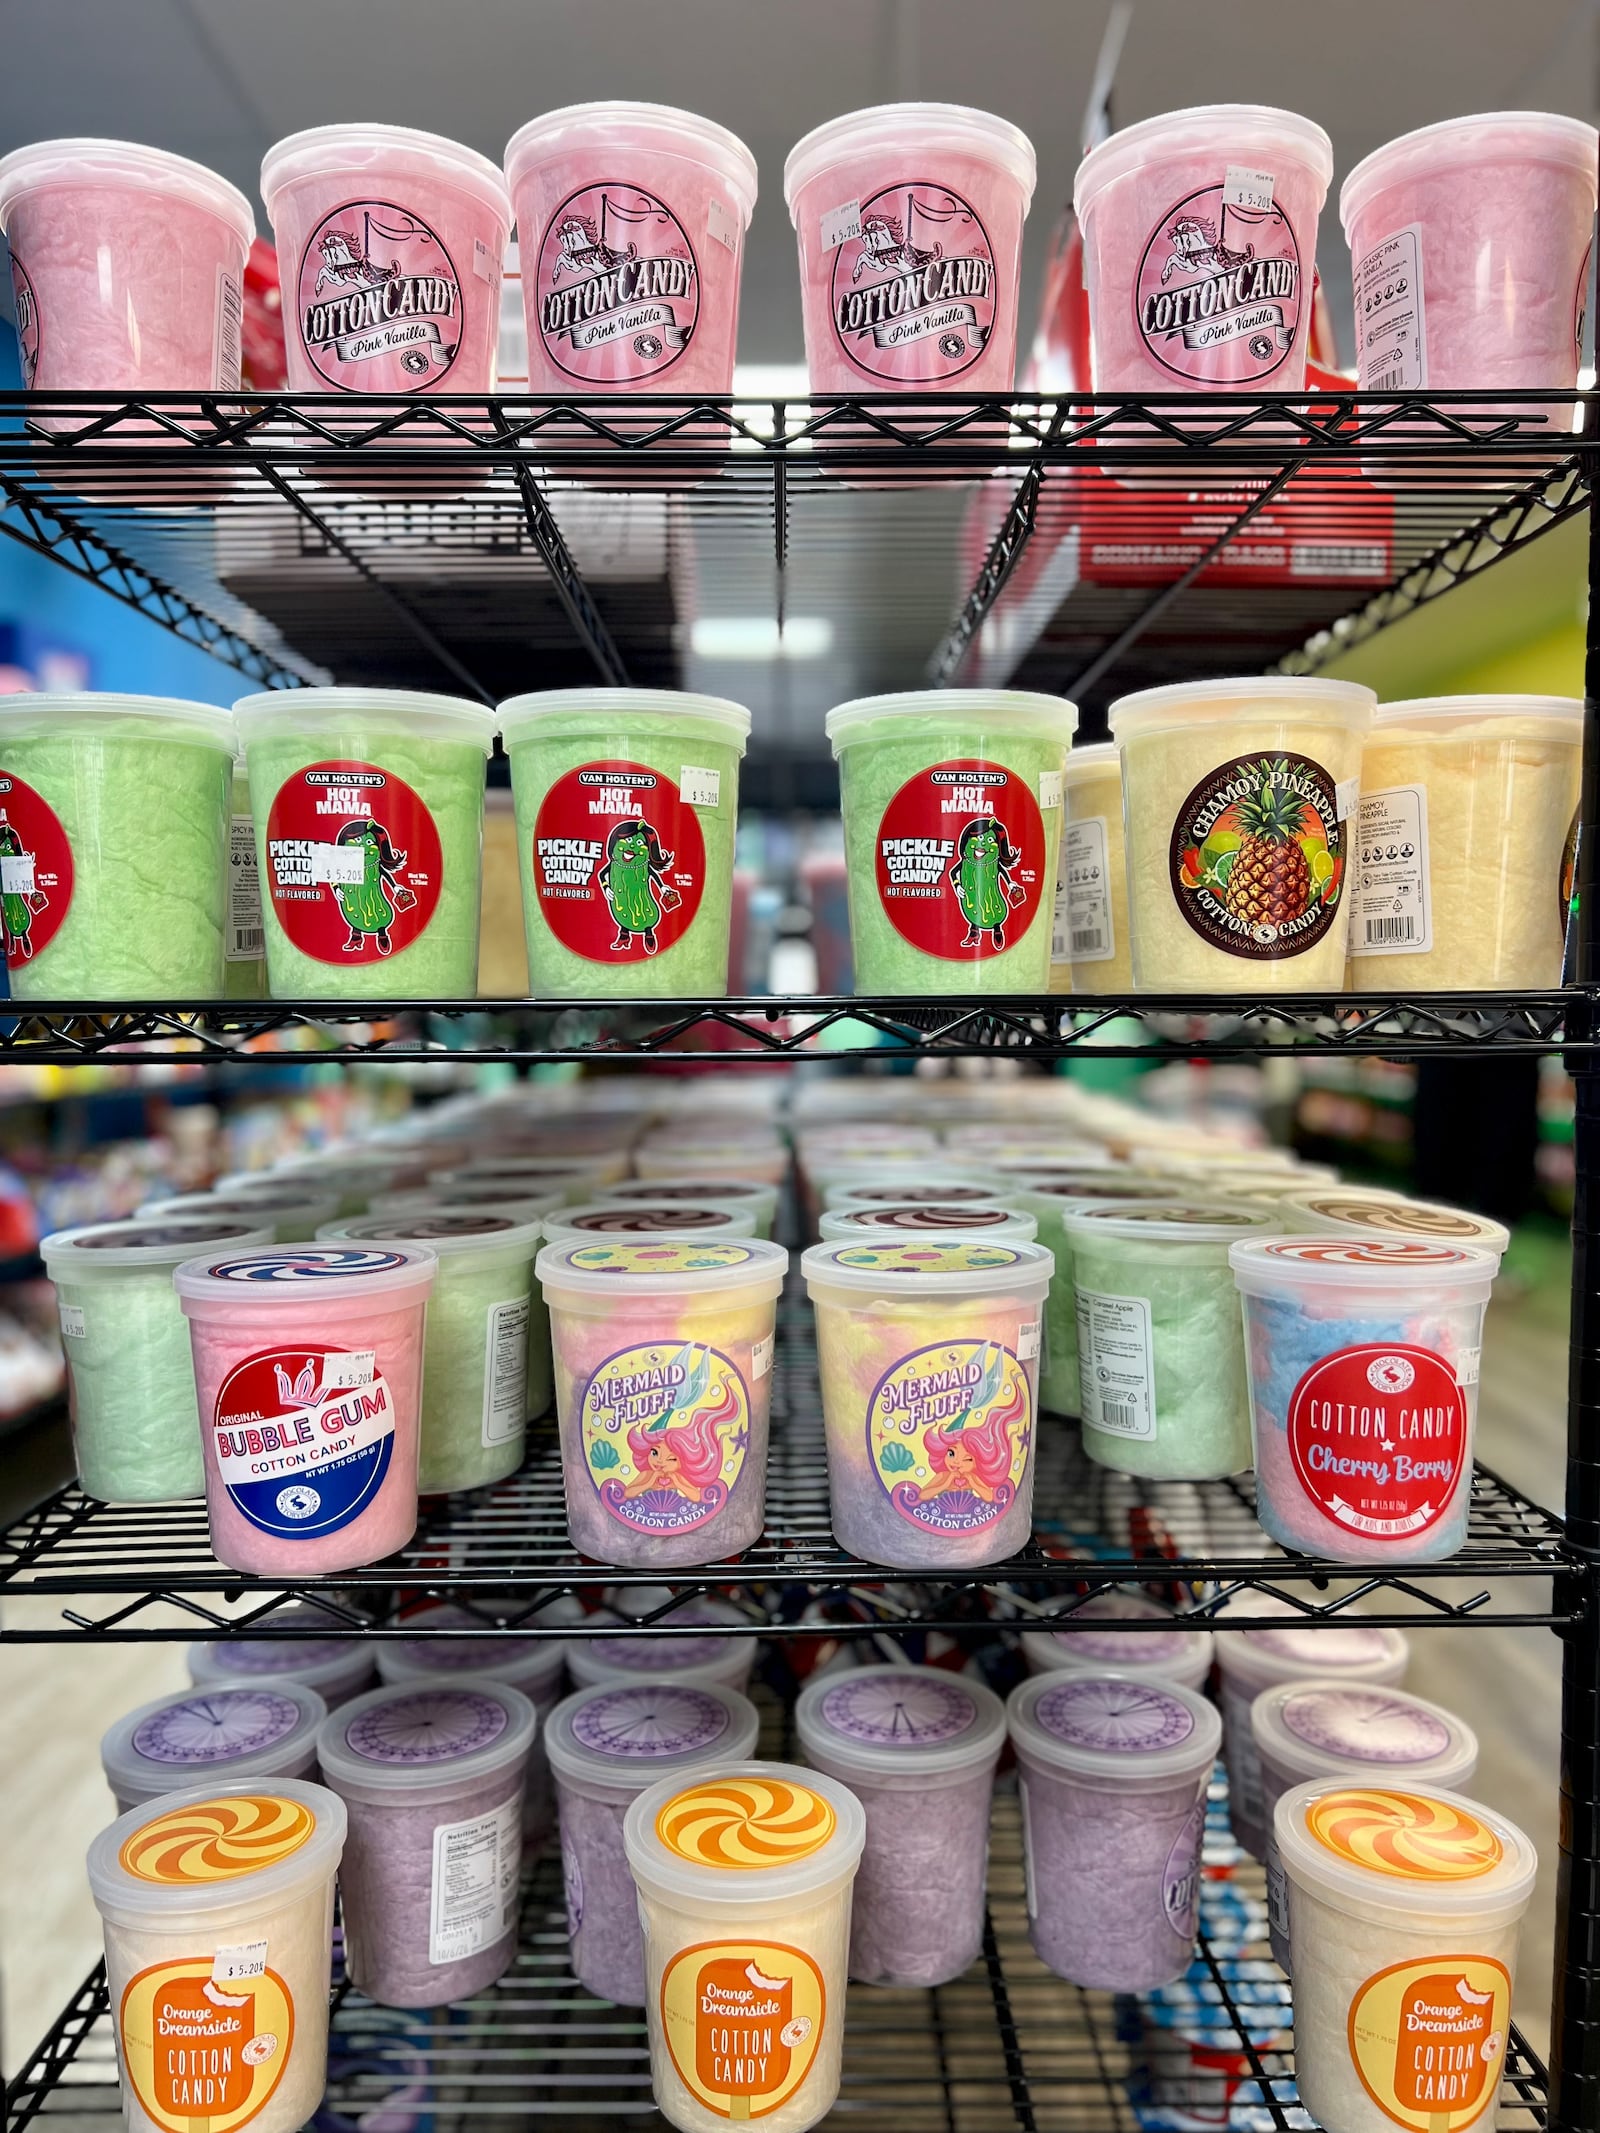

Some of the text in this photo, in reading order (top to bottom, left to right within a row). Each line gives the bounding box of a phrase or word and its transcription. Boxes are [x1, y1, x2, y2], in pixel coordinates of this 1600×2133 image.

[585, 309, 661, 344] Pink Vanilla
[889, 308, 964, 343] Pink Vanilla
[1199, 309, 1273, 345] Pink Vanilla
[350, 325, 426, 357] Pink Vanilla
[308, 774, 382, 785] VAN HOLTEN'S
[582, 774, 653, 786] VAN HOLTEN'S
[934, 773, 1004, 783] VAN HOLTEN'S
[326, 787, 361, 802] HOT
[599, 787, 633, 802] HOT
[952, 786, 985, 800] HOT
[316, 800, 372, 816] MAMA
[588, 800, 643, 817] MAMA
[940, 799, 994, 815] MAMA
[1192, 771, 1339, 845] CHAMOY PINEAPPLE
[1360, 801, 1385, 812] CHAMOY
[537, 839, 603, 860] PICKLE
[881, 838, 955, 857] PICKLE
[273, 857, 313, 871] COTTO
[541, 856, 594, 873] COTTON
[886, 856, 946, 871] COTTON
[544, 869, 591, 886] CANDY
[889, 869, 944, 885] CANDY
[275, 889, 321, 899] HOT FLAVORED
[542, 888, 591, 899] HOT FLAVORED
[887, 887, 941, 897] HOT FLAVORED
[1197, 888, 1254, 936] COTTON
[1278, 901, 1324, 937] CANDY
[1370, 1357, 1412, 1373] CHOCOLATE
[590, 1364, 686, 1411] MERMAID
[881, 1363, 982, 1414] MERMAID
[1370, 1375, 1412, 1392] STORYBOOK
[219, 1411, 264, 1425] ORIGINAL
[605, 1388, 677, 1433] FLUFF
[899, 1387, 974, 1434] FLUFF
[1310, 1399, 1454, 1439] COTTON CANDY
[217, 1389, 387, 1458] BUBBLE GUM
[251, 1434, 356, 1474] COTTON CANDY
[1308, 1443, 1453, 1485] Cherry Berry
[317, 1465, 329, 1475] WT
[331, 1460, 345, 1470] 1.75
[346, 1454, 357, 1463] OZ
[619, 1505, 706, 1527] COTTON CANDY
[913, 1506, 998, 1529] COTTON CANDY
[447, 1828, 478, 1841] Nutrition
[706, 1982, 754, 2003] Orange
[162, 2003, 213, 2023] Orange
[701, 1996, 781, 2016] Dreamsicle
[1413, 2000, 1463, 2019] Orange
[157, 2016, 242, 2036] Dreamsicle
[1406, 2013, 1484, 2033] Dreamsicle
[711, 2027, 772, 2055] COTTON
[168, 2046, 232, 2076] COTTON
[1414, 2043, 1475, 2072] COTTON
[714, 2057, 767, 2084] CANDY
[172, 2076, 228, 2105] CANDY
[1415, 2072, 1469, 2101] CANDY
